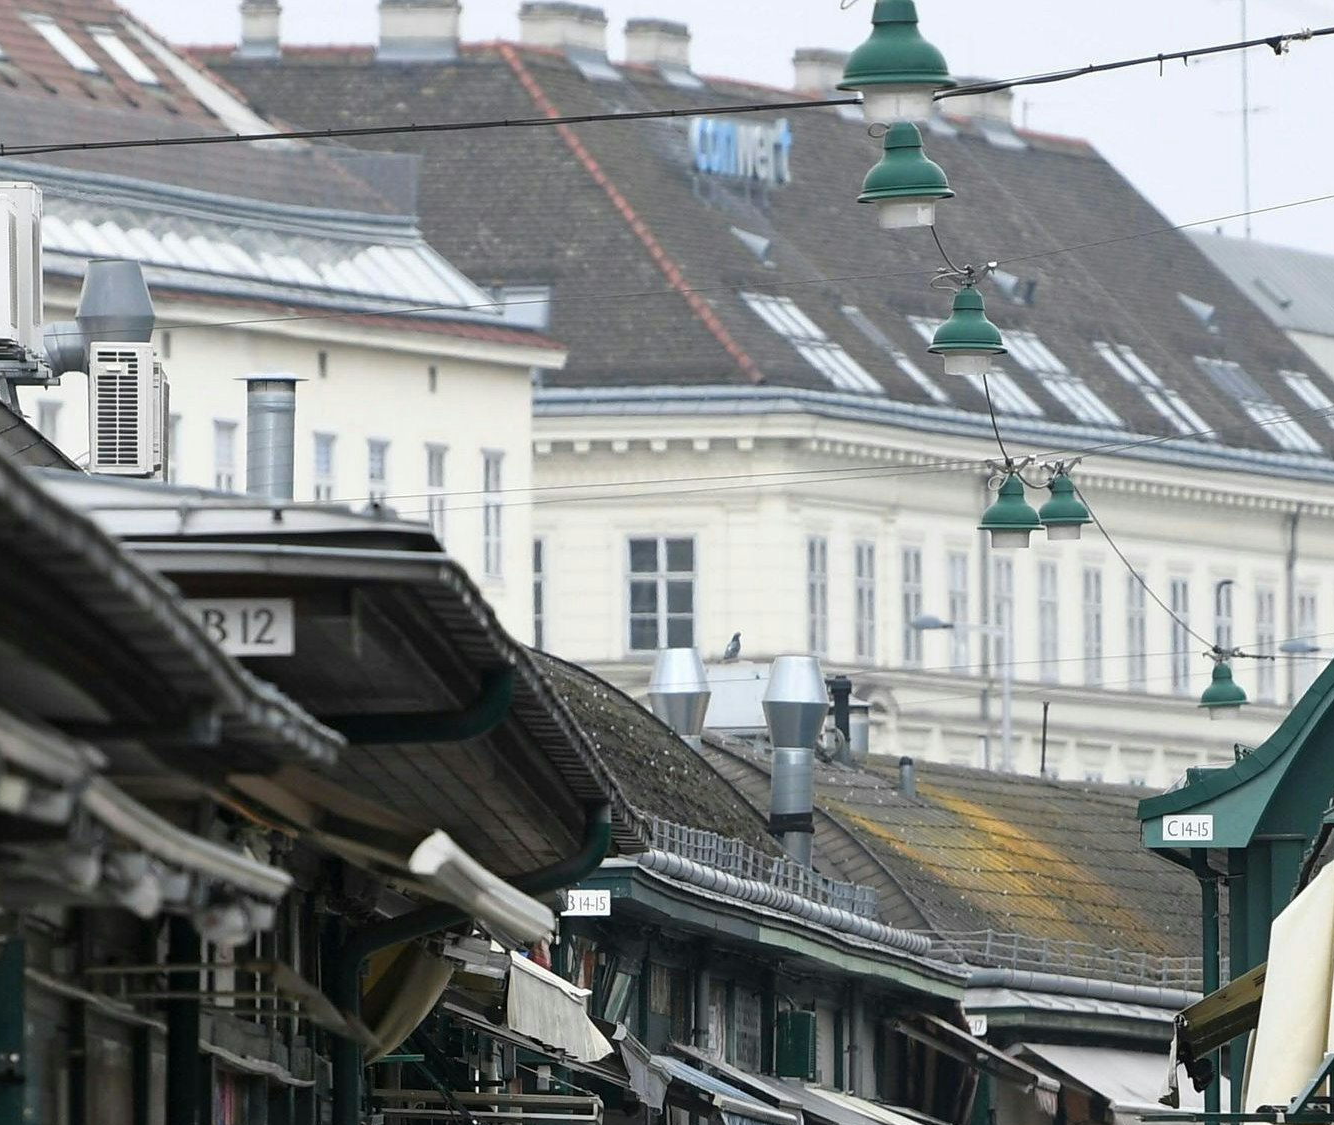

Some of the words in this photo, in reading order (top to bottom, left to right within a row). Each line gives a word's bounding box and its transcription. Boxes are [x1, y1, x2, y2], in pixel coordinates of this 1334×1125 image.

[203, 608, 226, 643] B
[241, 608, 274, 644] 12
[1167, 820, 1178, 837] C
[1181, 821, 1209, 837] 14-15
[579, 896, 607, 911] 14-15
